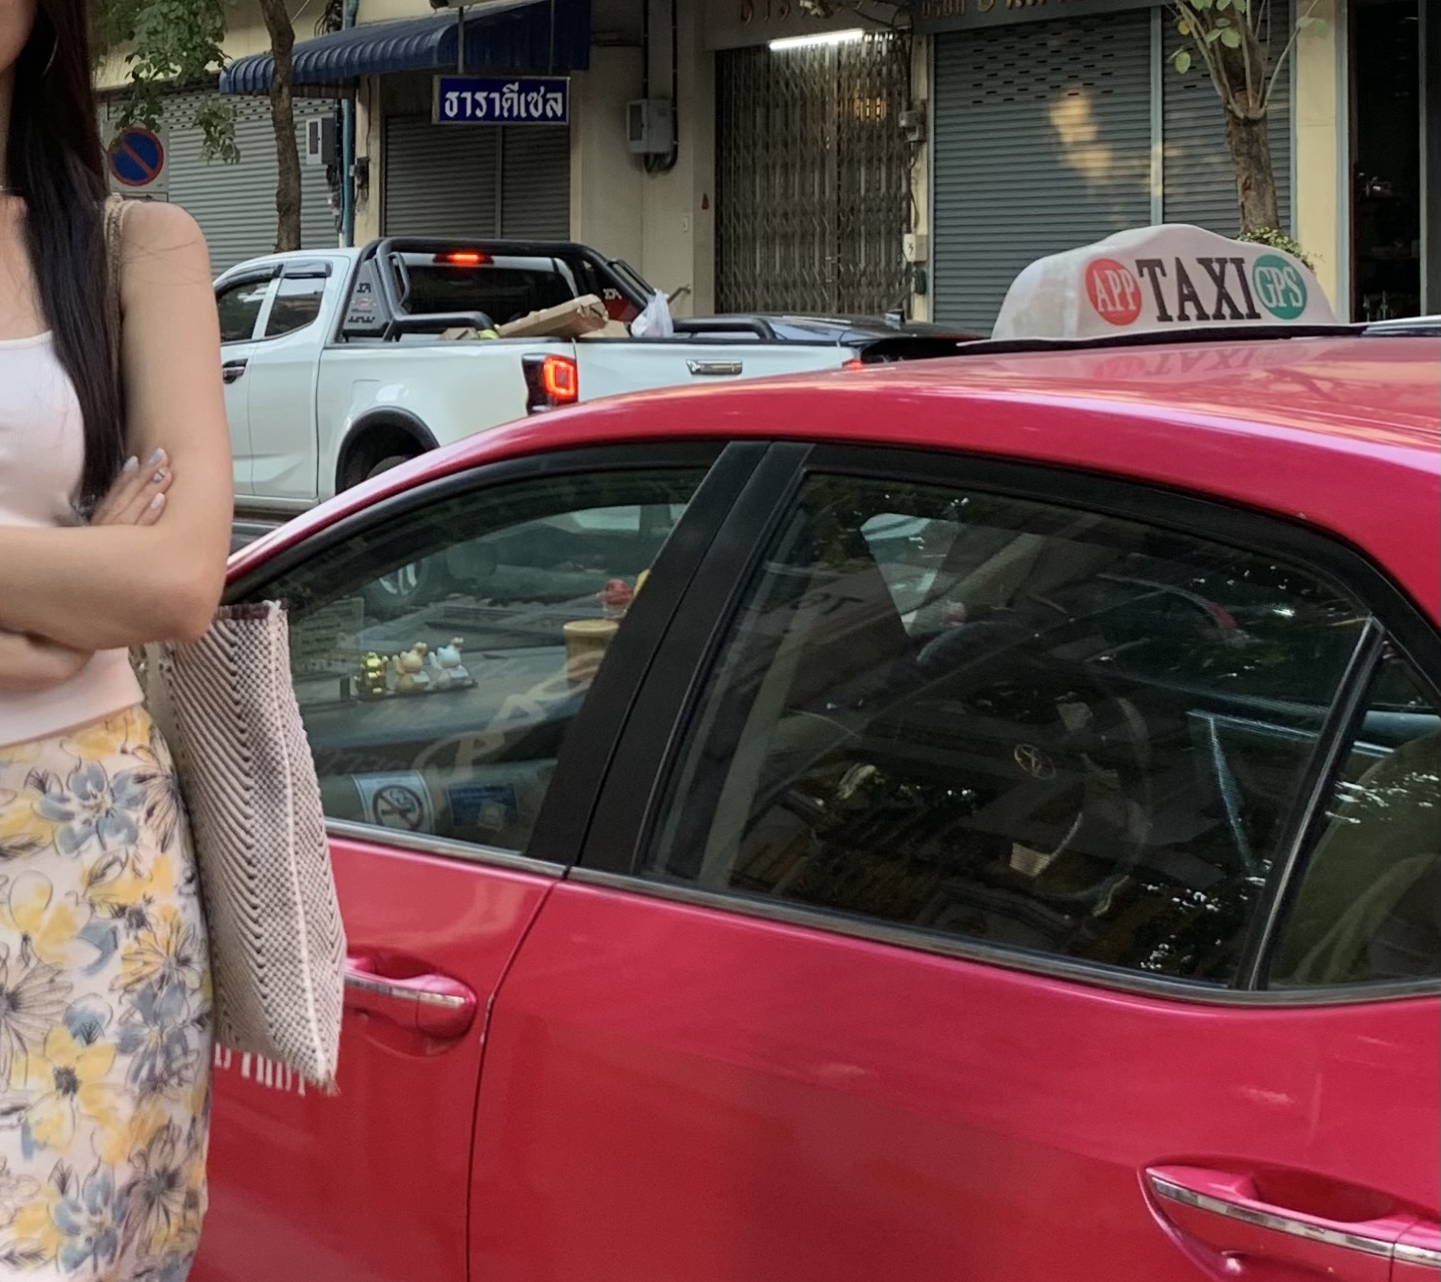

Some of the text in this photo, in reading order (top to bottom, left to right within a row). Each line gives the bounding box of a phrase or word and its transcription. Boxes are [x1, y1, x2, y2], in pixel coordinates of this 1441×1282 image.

[444, 81, 563, 118] ธาราดีเซล
[1092, 257, 1304, 322] APP TAXI GPS
